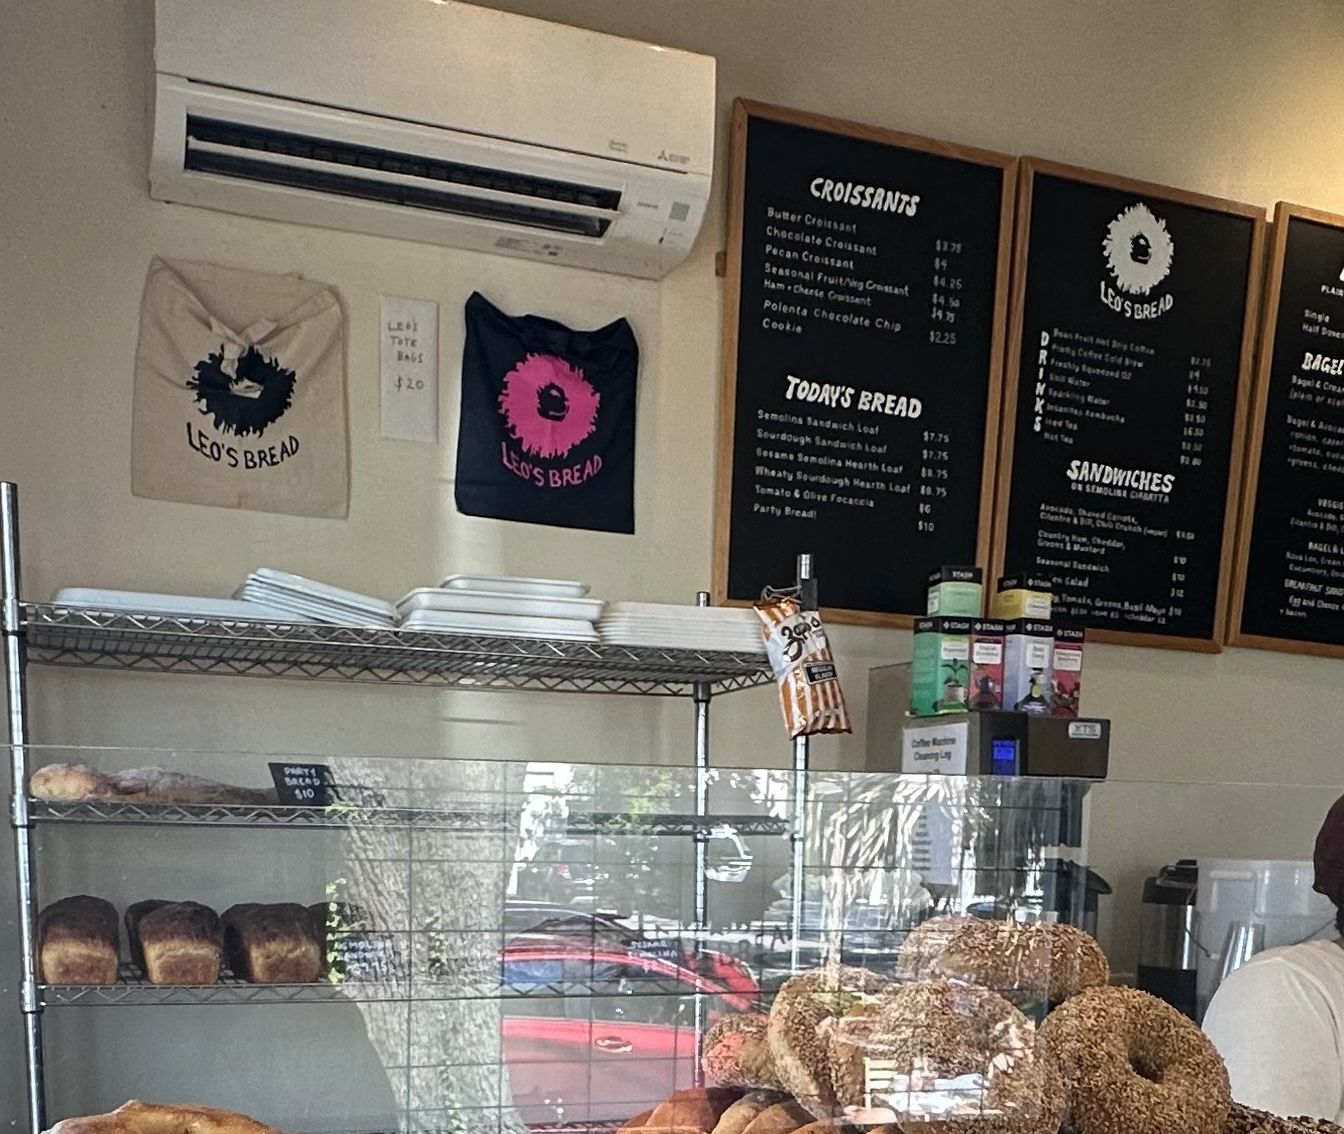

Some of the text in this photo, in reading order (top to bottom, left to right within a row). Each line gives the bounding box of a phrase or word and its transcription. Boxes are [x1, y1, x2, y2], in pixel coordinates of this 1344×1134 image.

[810, 177, 921, 217] CROISSANTS
[767, 207, 856, 233] Butter Croissant
[766, 225, 877, 256] Chocolate Croissant
[765, 244, 854, 270] Pecan Croissant
[764, 262, 814, 280] Seasonal
[1100, 281, 1173, 320] LEO'S BREAD
[762, 318, 802, 334] Cookie
[763, 300, 808, 317] Polenta
[813, 308, 870, 327] Chocolate
[875, 318, 902, 332] Chip
[1304, 309, 1330, 323] Single
[1301, 352, 1344, 376] BAGEL
[1033, 331, 1050, 432] DRINKS
[785, 375, 922, 419] TODAY'S BREAD
[757, 409, 804, 425] Semolina
[807, 417, 854, 432] Sandwich
[857, 423, 879, 435] Loaf
[186, 421, 300, 470] LEO'S BREAD
[757, 428, 812, 446] Sourdough
[815, 435, 862, 451] Sandwich
[865, 442, 887, 454] Loaf
[501, 441, 602, 488] LEO'S BREAD
[756, 448, 903, 475] Sesame Semolina Hearth Loaf
[796, 470, 850, 488] Sourdough
[853, 478, 886, 491] Hearth
[888, 482, 911, 494] Loaf
[1066, 459, 1176, 493] SANDWICHES
[755, 484, 791, 498] Tomato
[803, 489, 828, 502] Olive
[830, 494, 874, 507] Focaccia
[1070, 482, 1084, 492] ON
[1085, 484, 1128, 499] SEMOLINA
[753, 503, 934, 532] Party $10
[284, 767, 317, 778] PARTY
[285, 777, 321, 787] BREAD
[294, 789, 315, 800] $10
